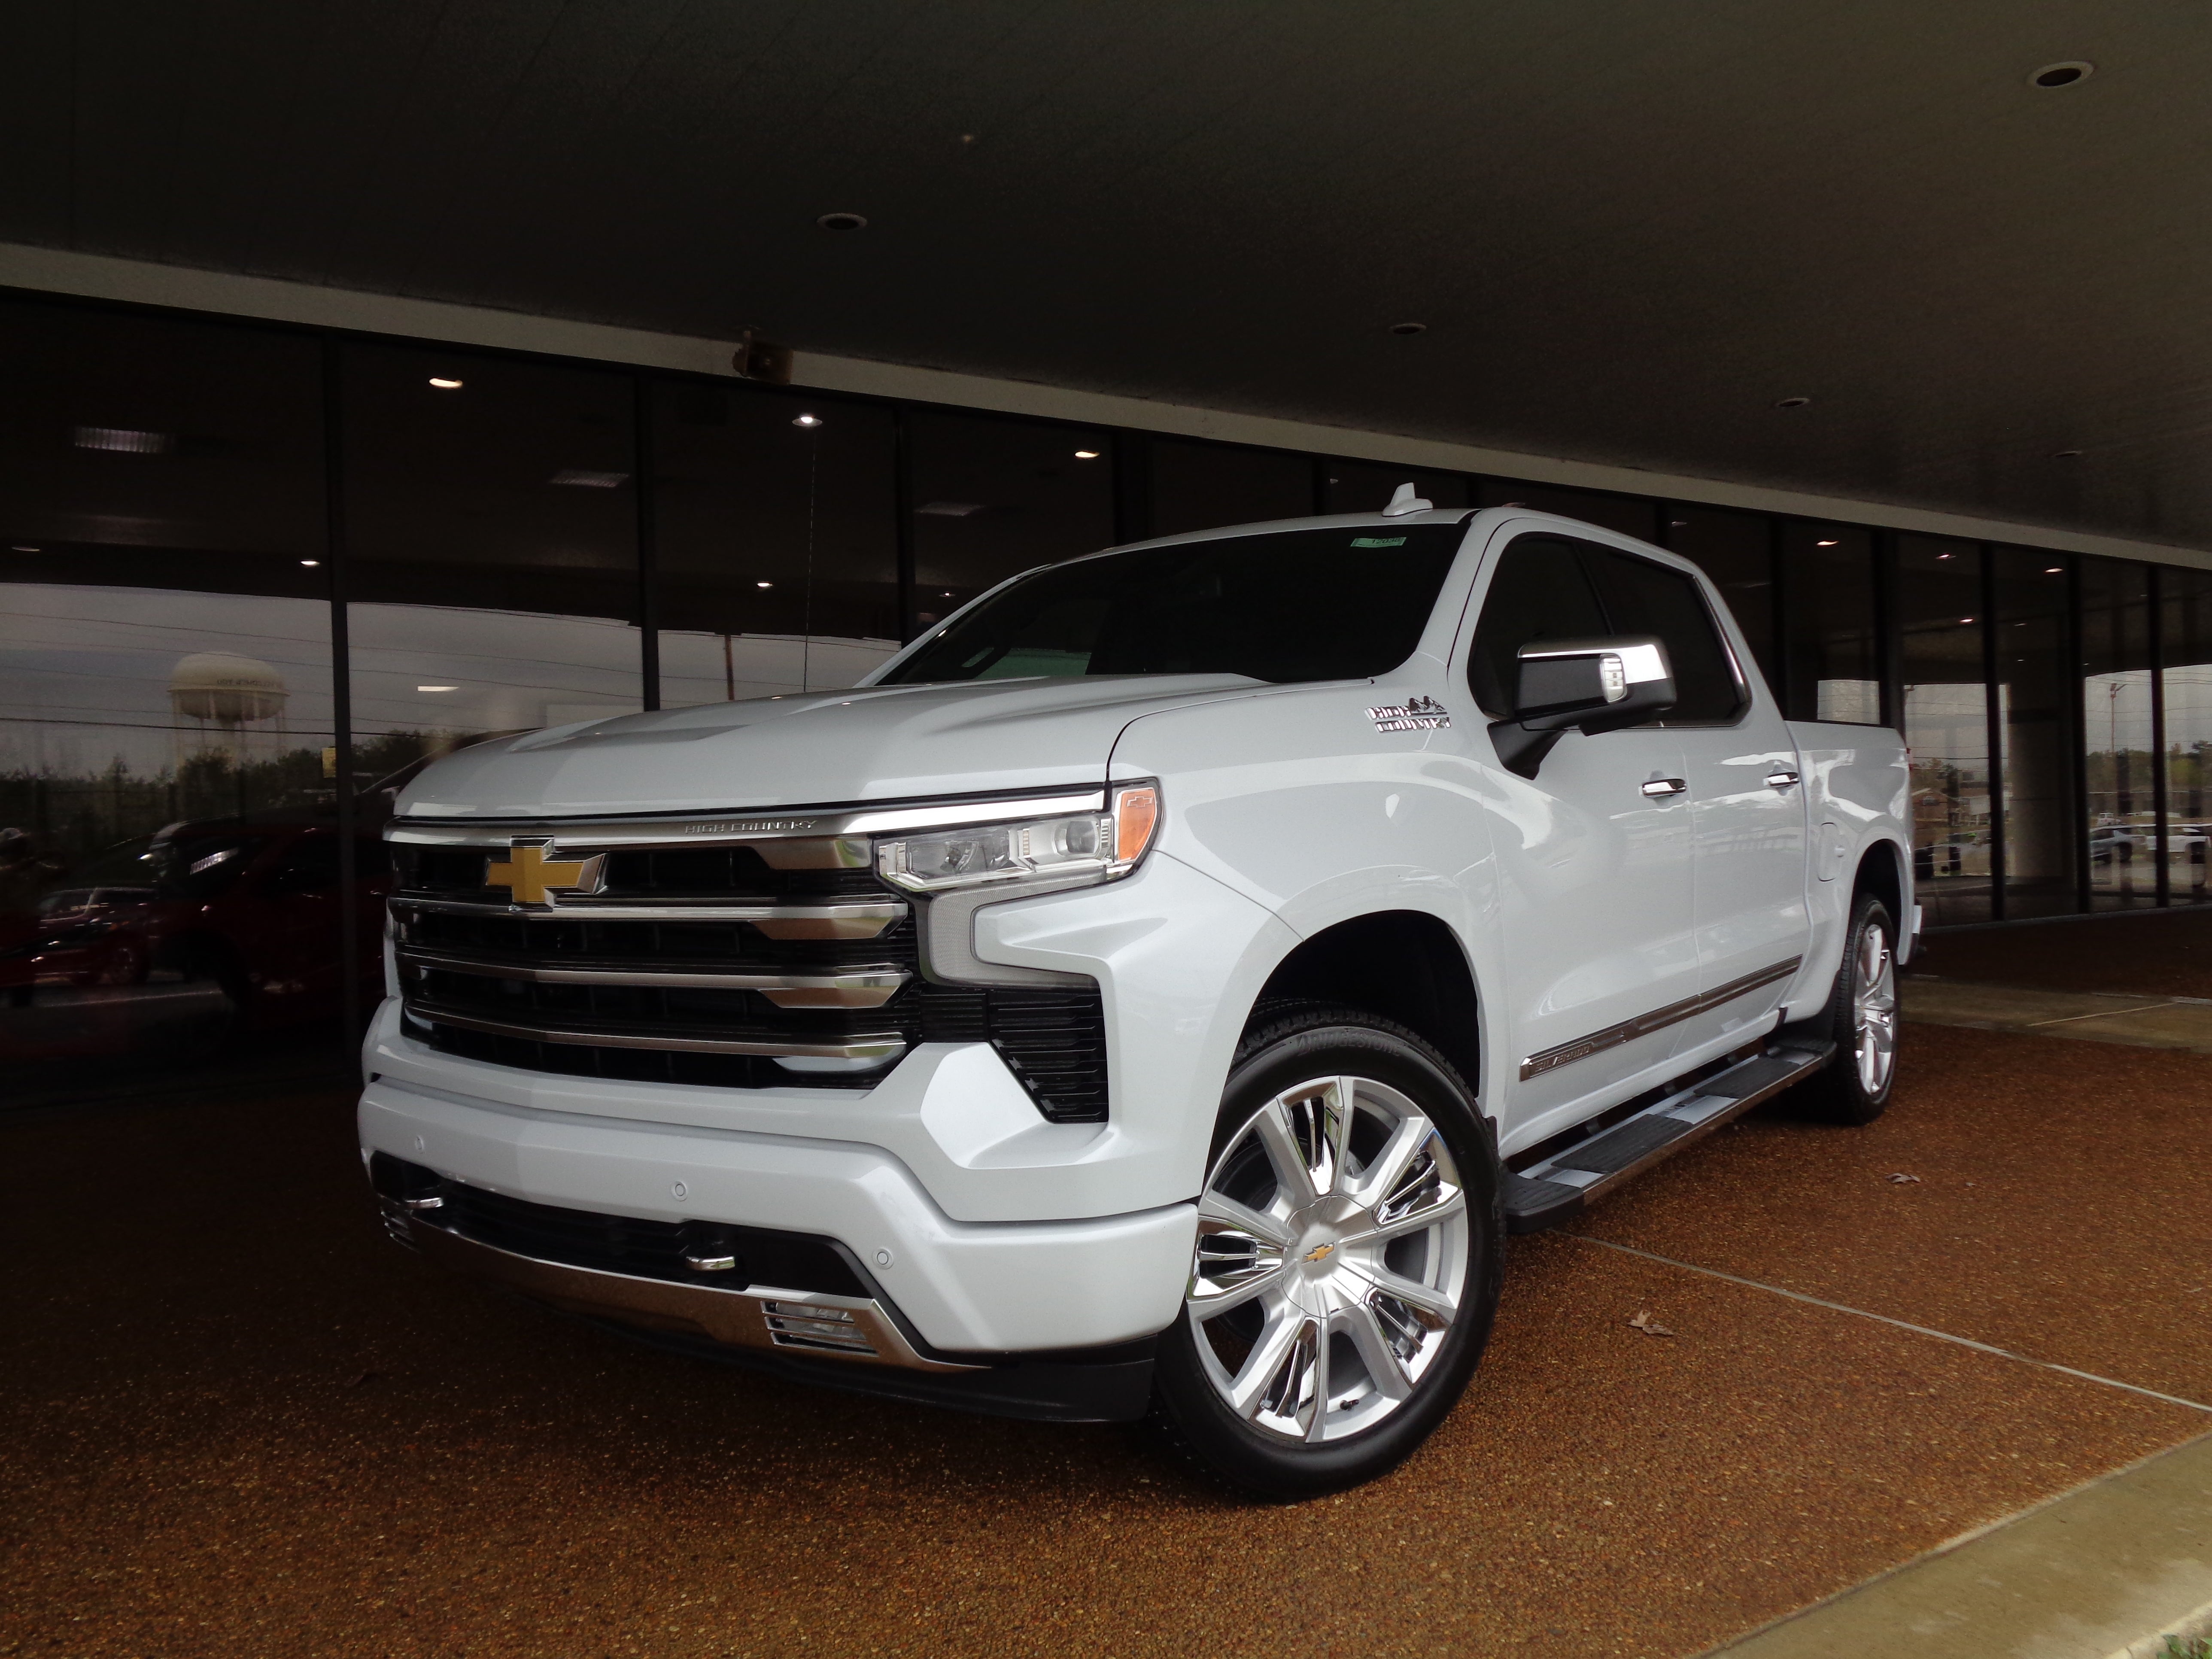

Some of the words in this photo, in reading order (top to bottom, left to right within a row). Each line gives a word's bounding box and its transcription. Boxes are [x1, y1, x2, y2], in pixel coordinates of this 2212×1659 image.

[685, 823, 725, 834] HIGH
[731, 820, 817, 831] COUNTRY
[1297, 1032, 1400, 1057] BRIDGESTONE
[1535, 1046, 1589, 1073] SILVERADO
